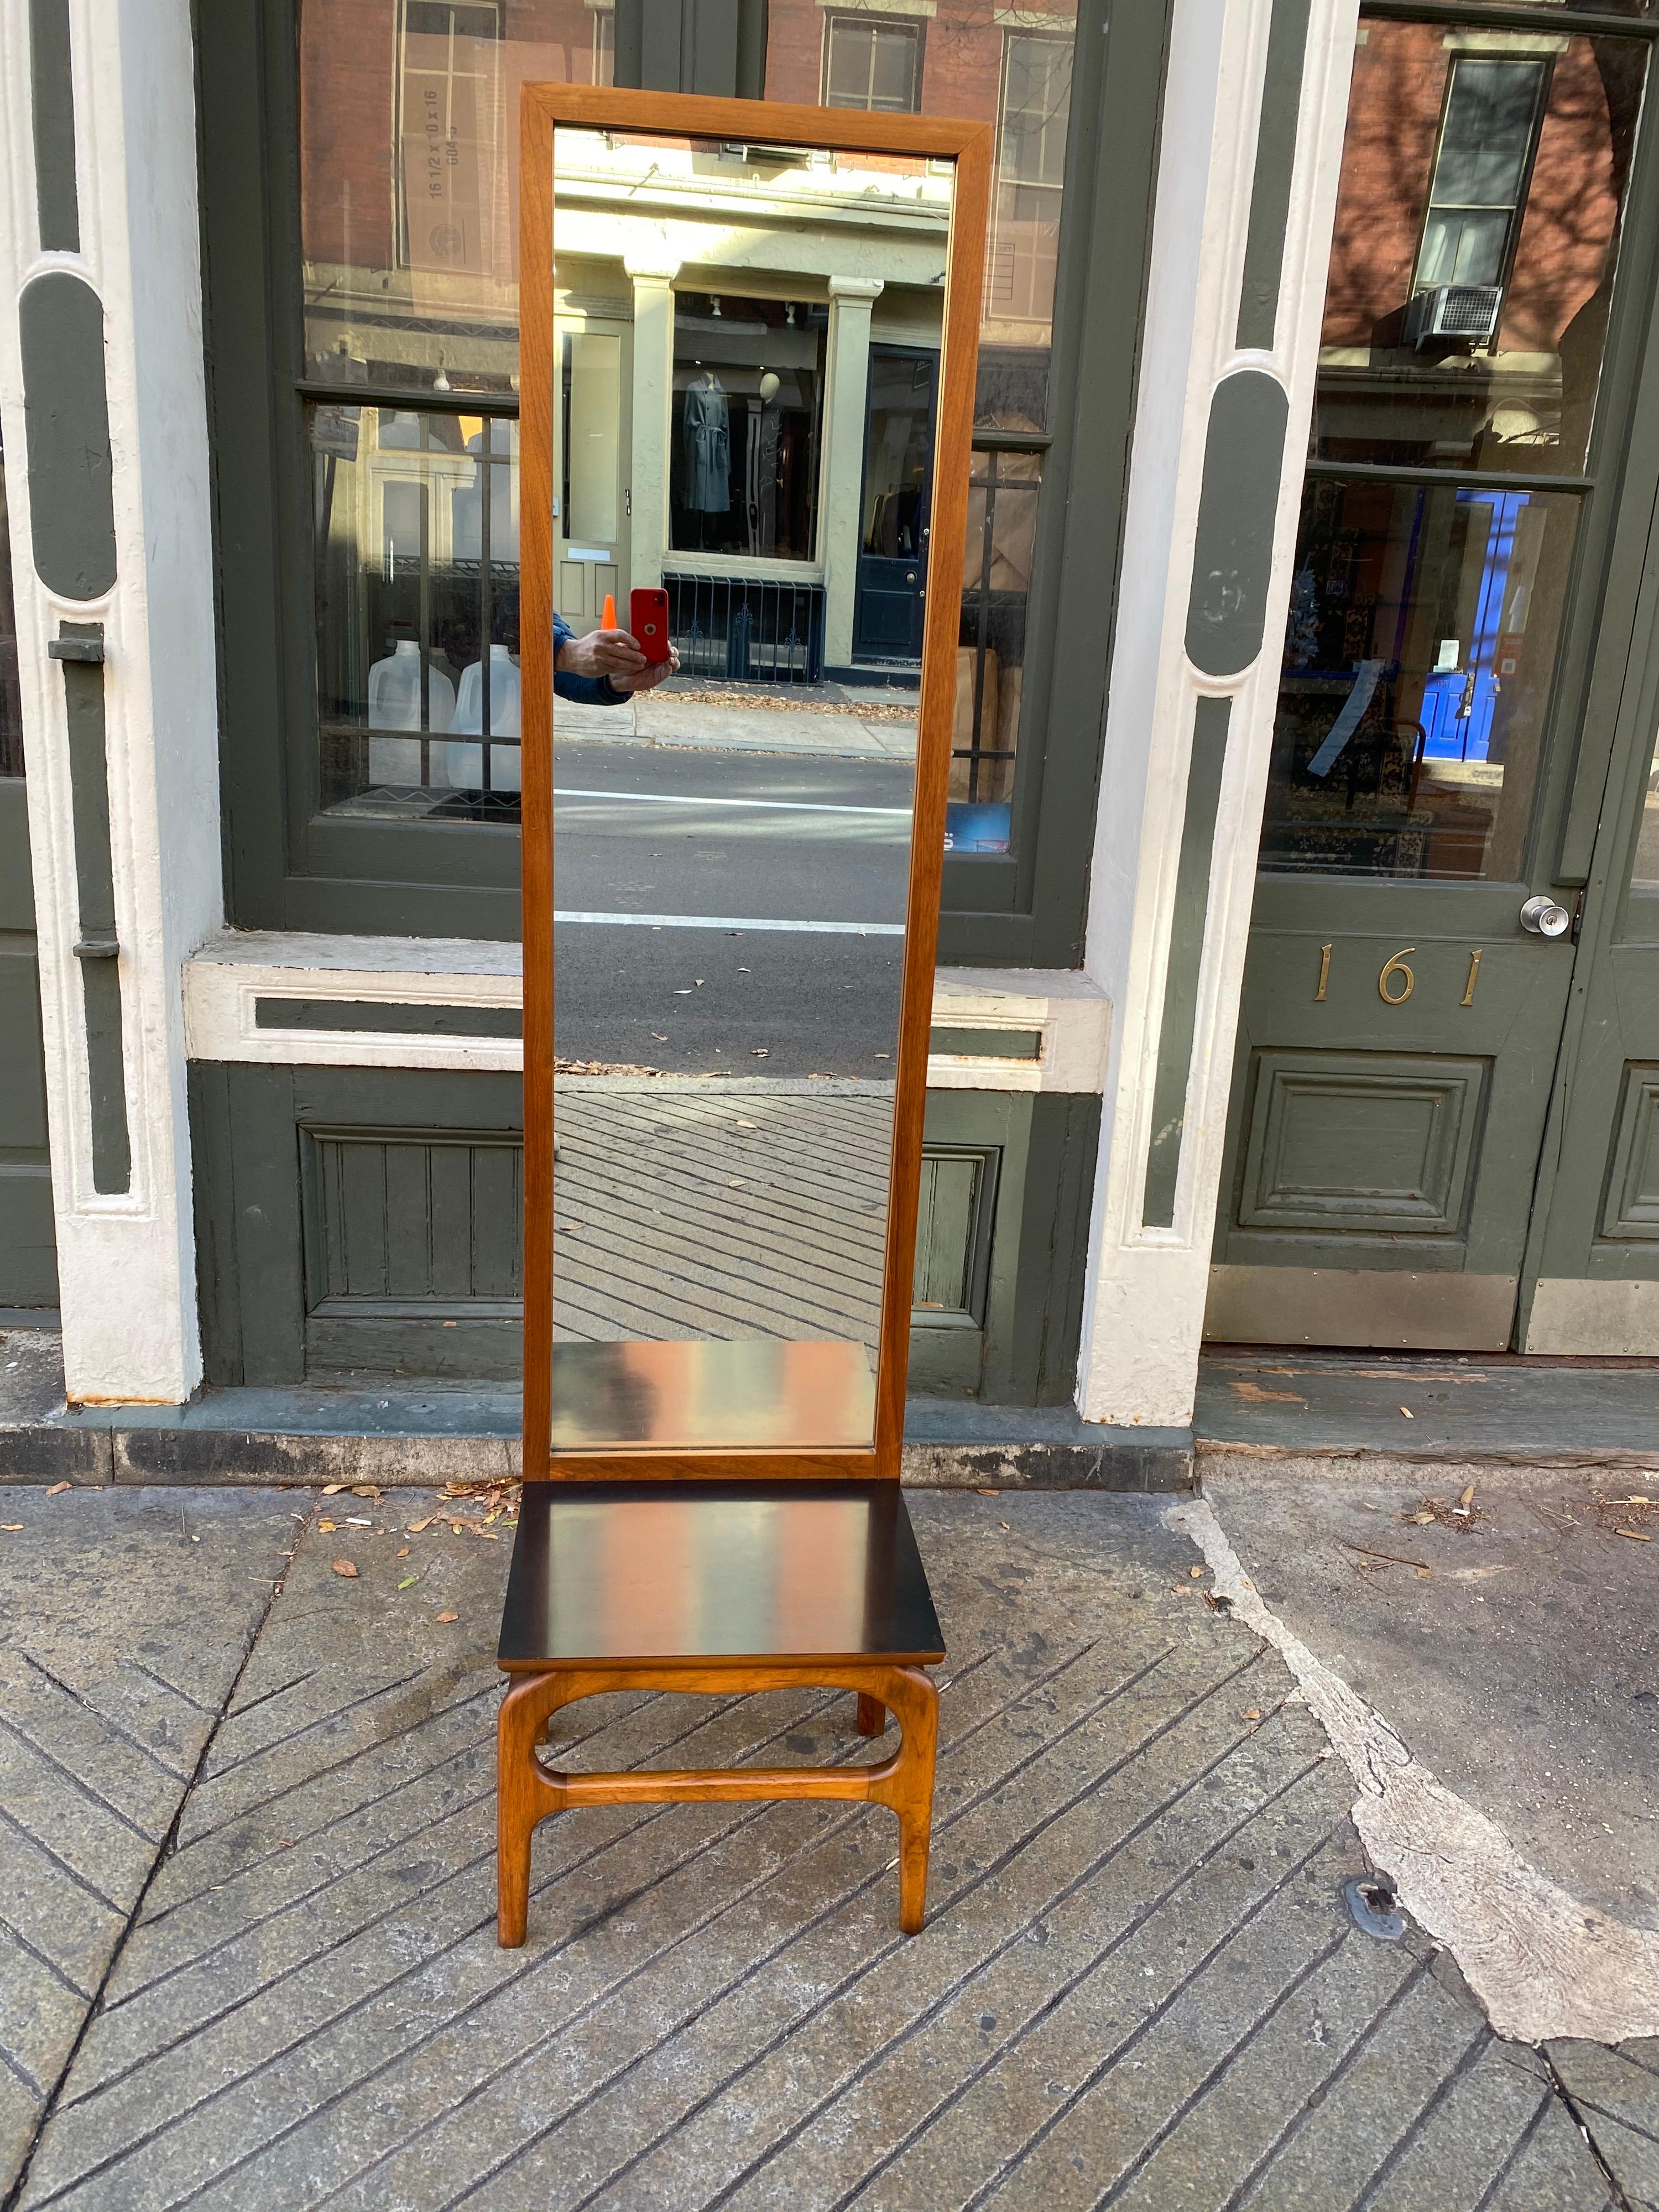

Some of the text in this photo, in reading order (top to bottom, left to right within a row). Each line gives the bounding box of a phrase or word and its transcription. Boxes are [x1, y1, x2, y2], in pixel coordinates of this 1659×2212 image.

[424, 90, 437, 107] 16
[429, 183, 442, 199] 16
[1313, 943, 1483, 1006] 161
